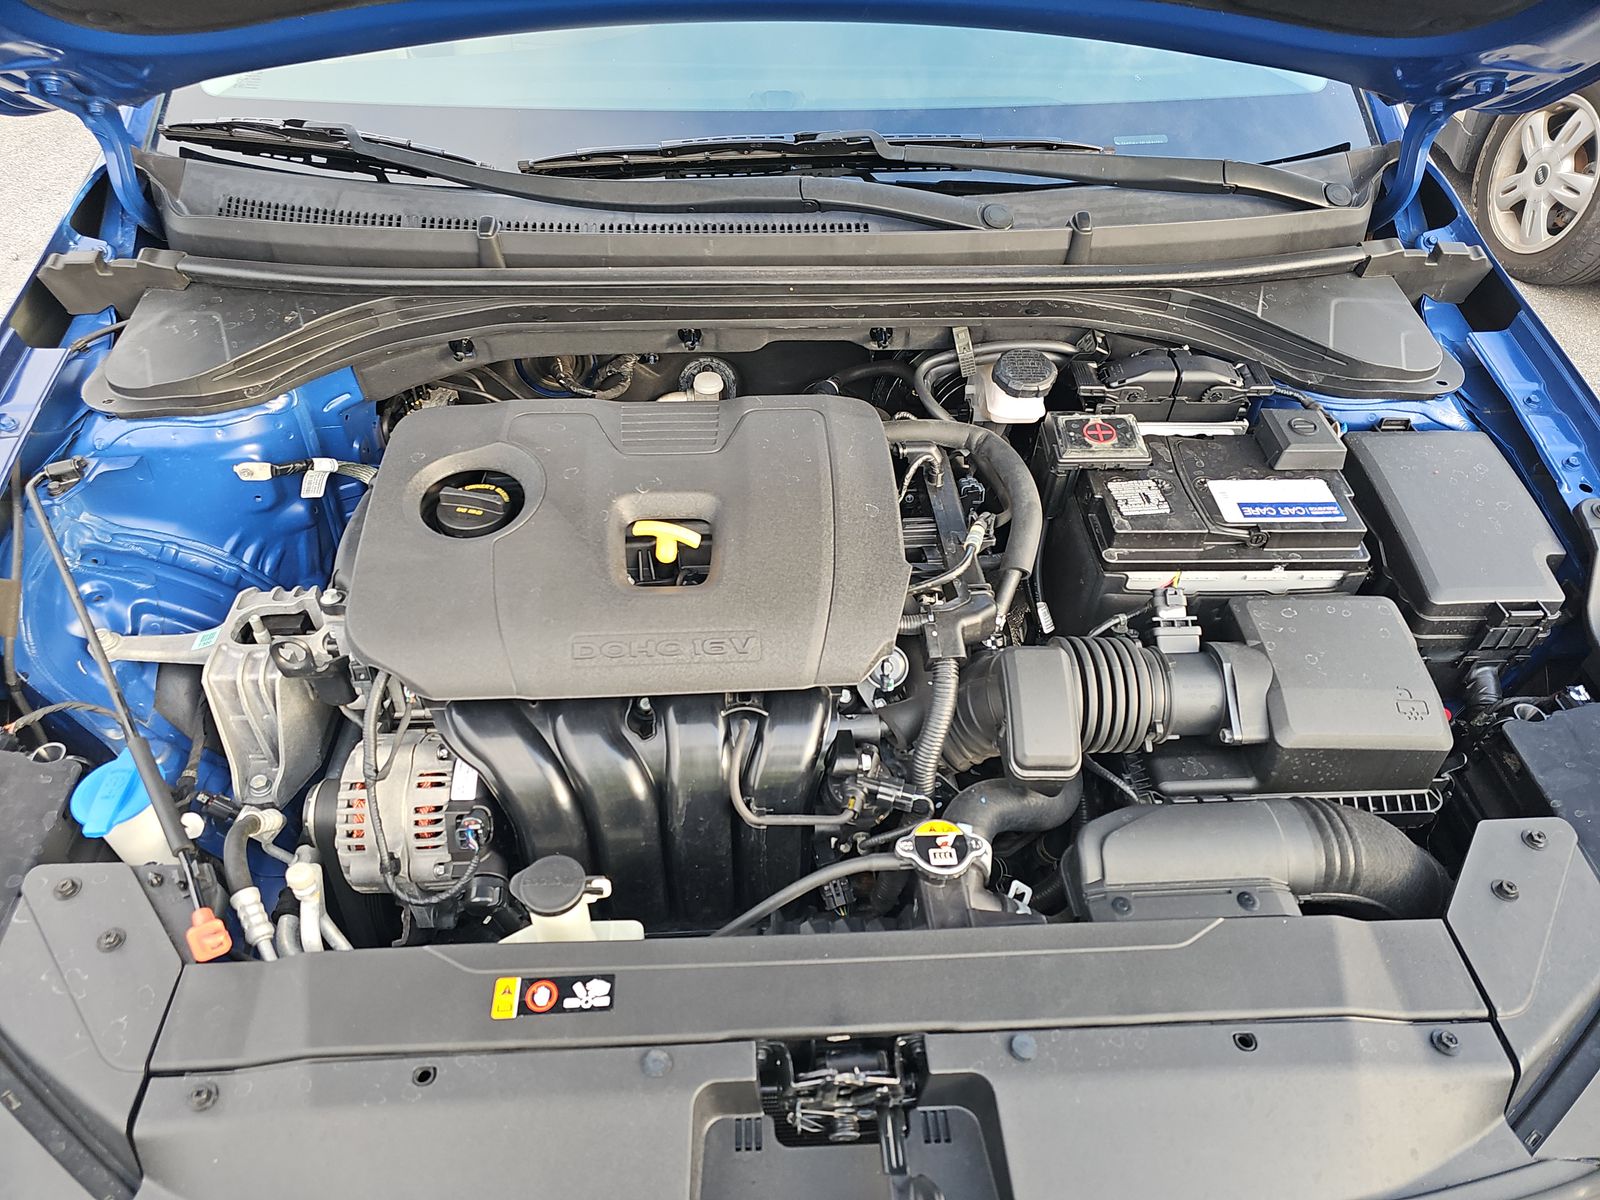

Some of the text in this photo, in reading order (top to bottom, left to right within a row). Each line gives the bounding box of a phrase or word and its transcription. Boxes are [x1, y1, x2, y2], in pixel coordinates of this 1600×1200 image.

[1241, 506, 1277, 516] CARE
[1278, 506, 1305, 516] CAR
[572, 635, 757, 661] DOHC 16V
